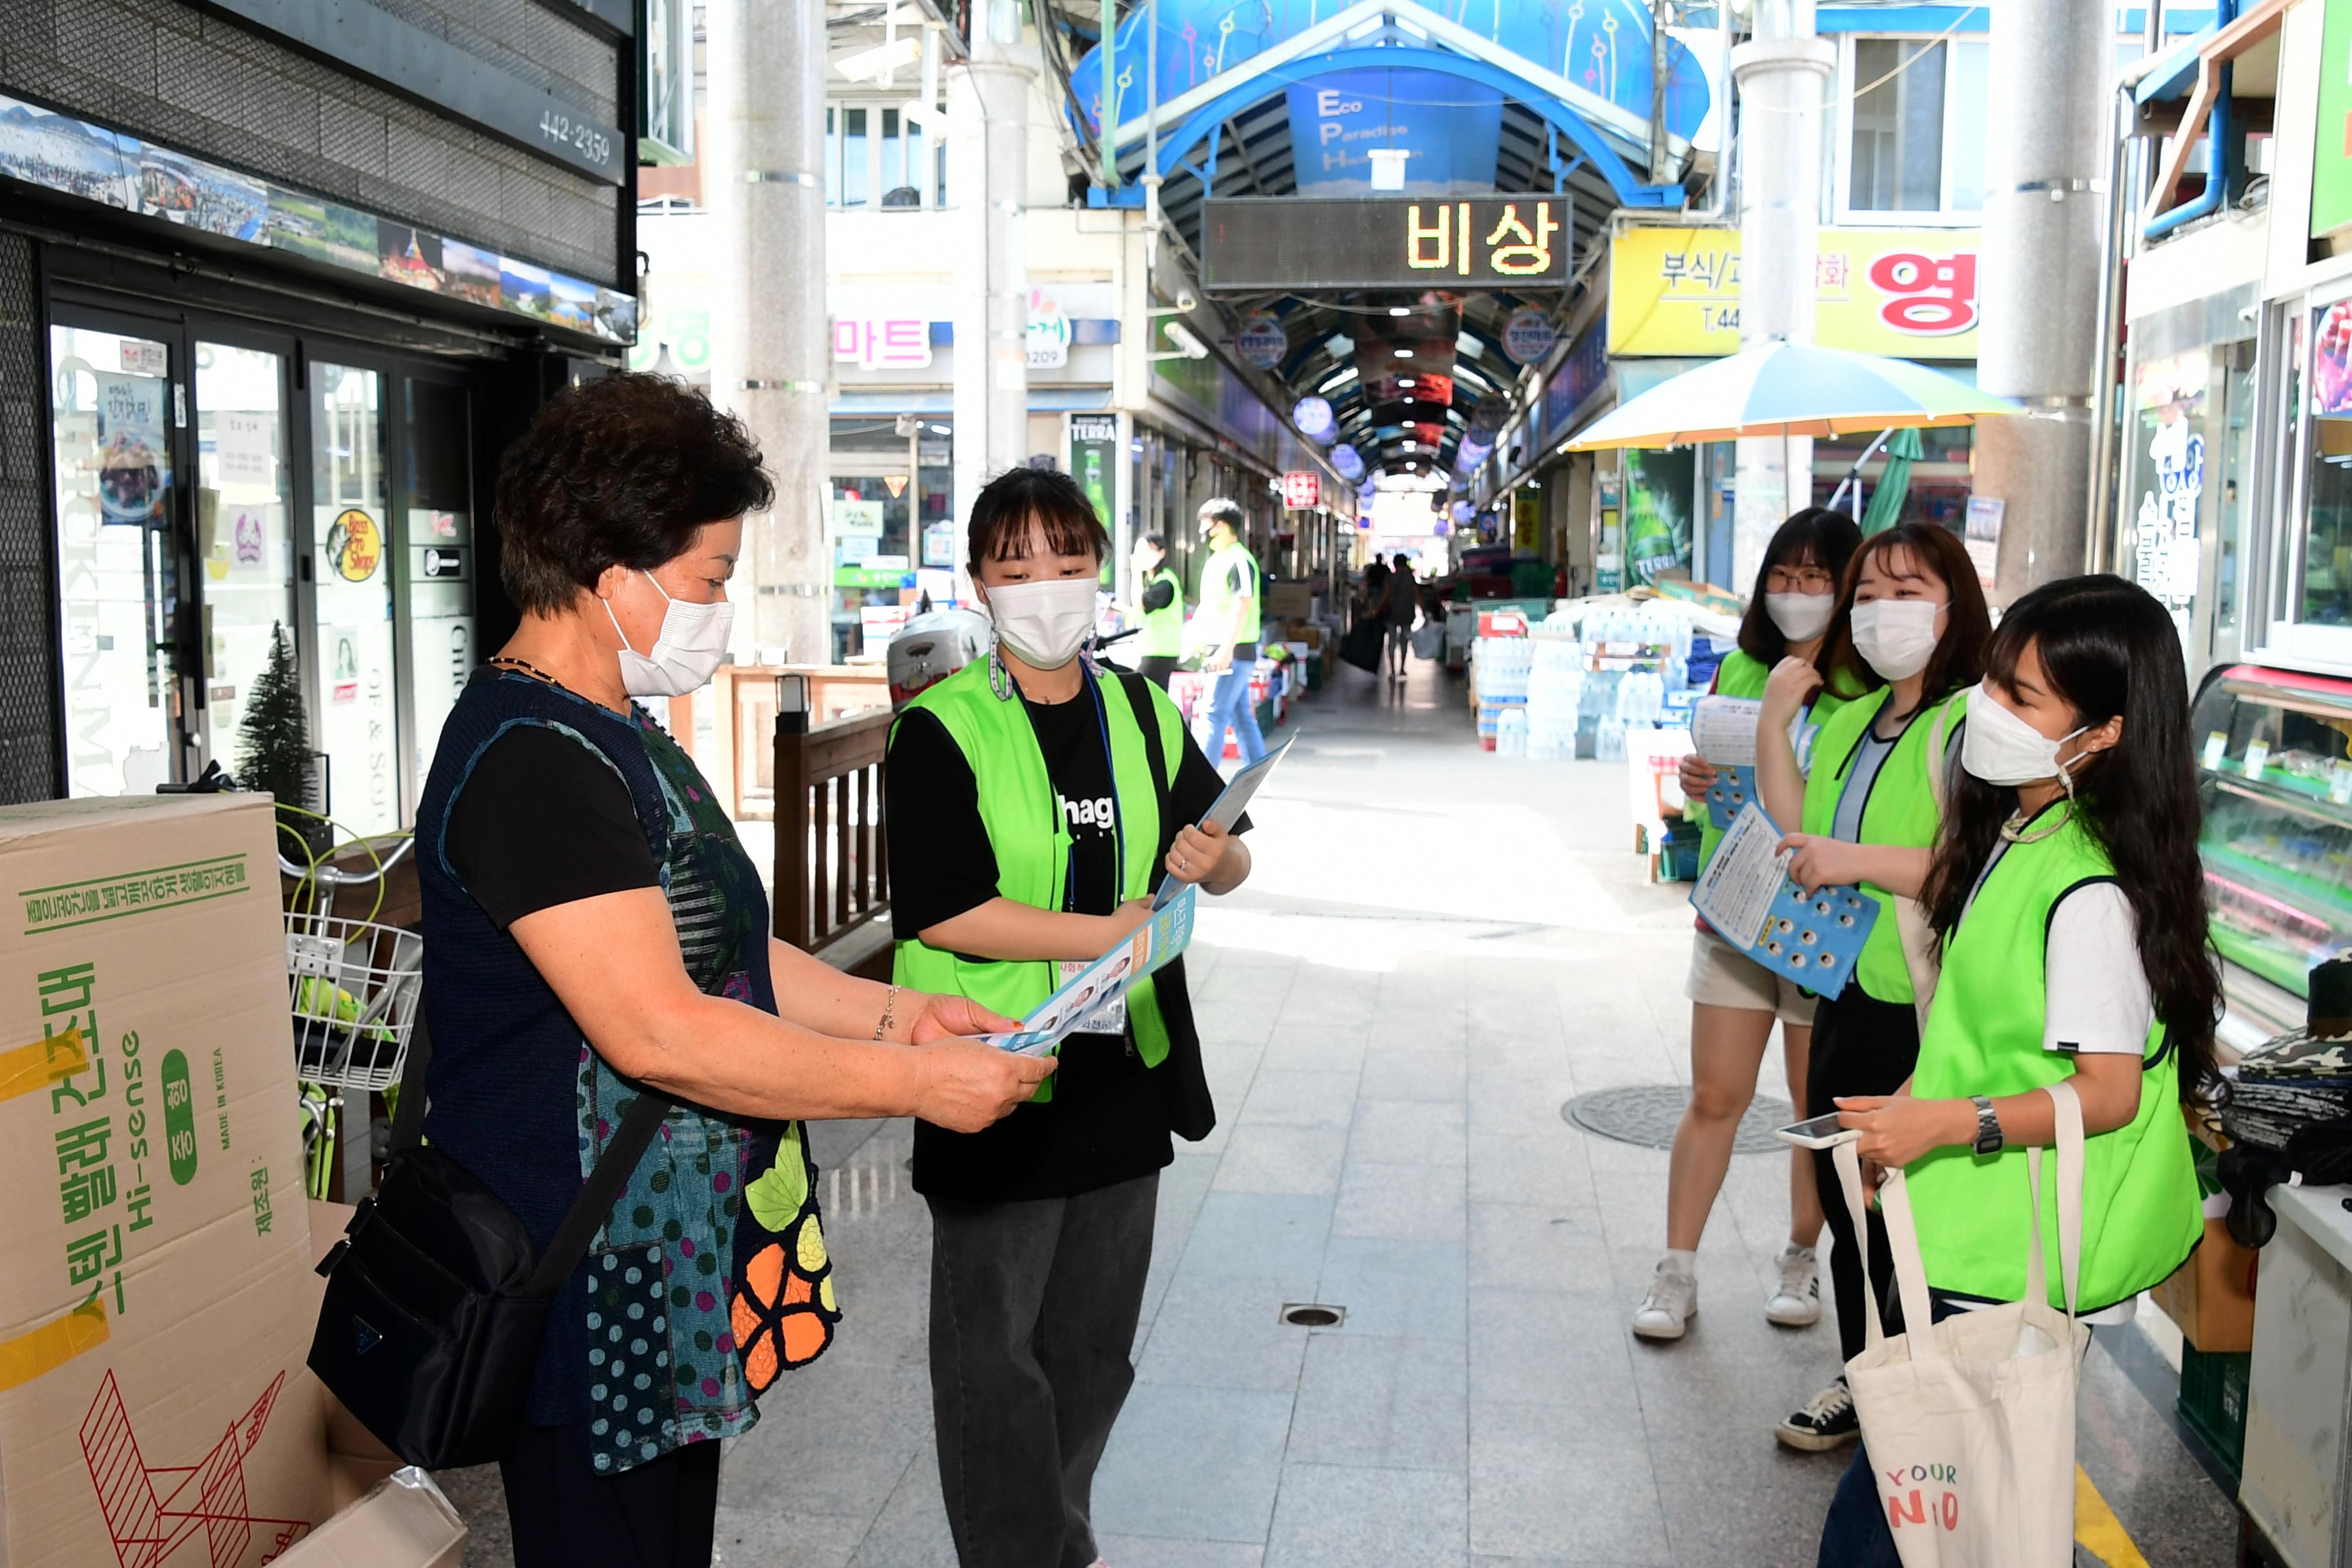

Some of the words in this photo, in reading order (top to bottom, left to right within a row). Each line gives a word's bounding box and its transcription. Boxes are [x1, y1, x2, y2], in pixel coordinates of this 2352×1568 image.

[1317, 89, 1363, 118] Eco
[539, 110, 610, 166] 442-2359
[1319, 122, 1408, 147] Paradise
[1408, 202, 1559, 276] 비상
[1816, 253, 1849, 289] 화
[1869, 252, 1979, 335] 영
[834, 320, 925, 364] 마트
[1071, 423, 1116, 442] TERRA
[348, 514, 368, 534] Bass
[348, 534, 365, 552] Pro
[350, 550, 375, 574] Shops
[37, 961, 107, 1115] 건조대
[213, 1046, 225, 1084] KOREA
[217, 1085, 227, 1108] IN
[121, 1030, 154, 1233] Hi-sense
[221, 1109, 231, 1151] MADE
[55, 1115, 118, 1224] 빨래
[66, 1222, 126, 1322] 스텐
[1886, 1462, 1957, 1486] YOUR
